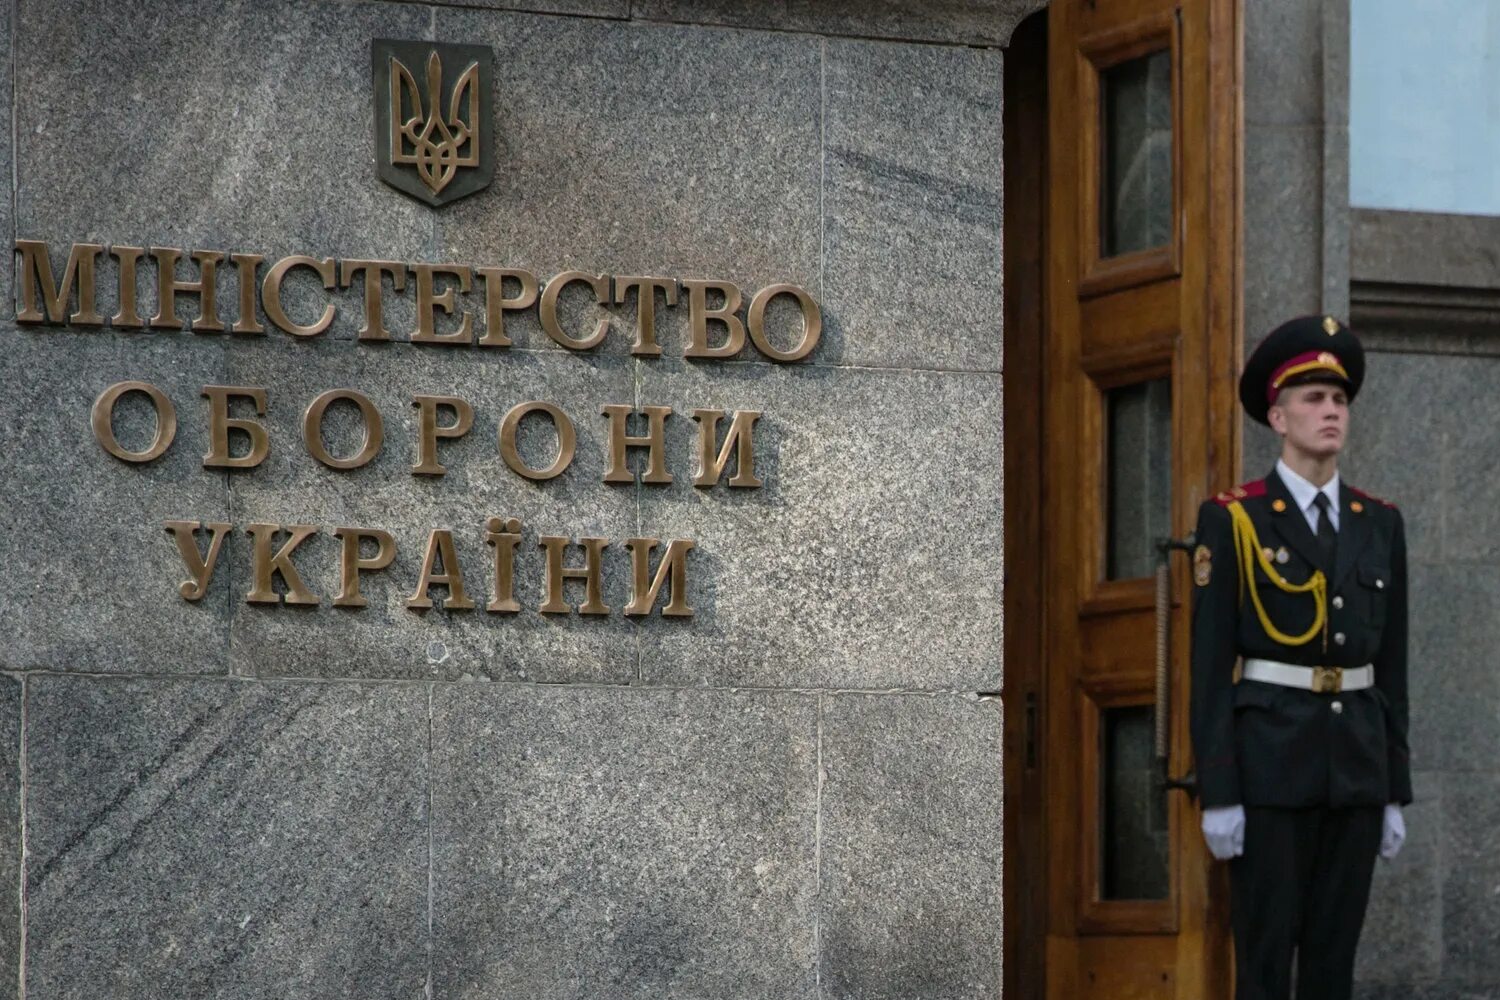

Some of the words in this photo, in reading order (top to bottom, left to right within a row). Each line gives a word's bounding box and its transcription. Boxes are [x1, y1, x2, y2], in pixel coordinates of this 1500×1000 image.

[14, 239, 822, 362] МІНІСТЕРСТВО
[91, 380, 763, 489] ОБОРОНИ
[164, 517, 695, 616] УКРАЇНИ
